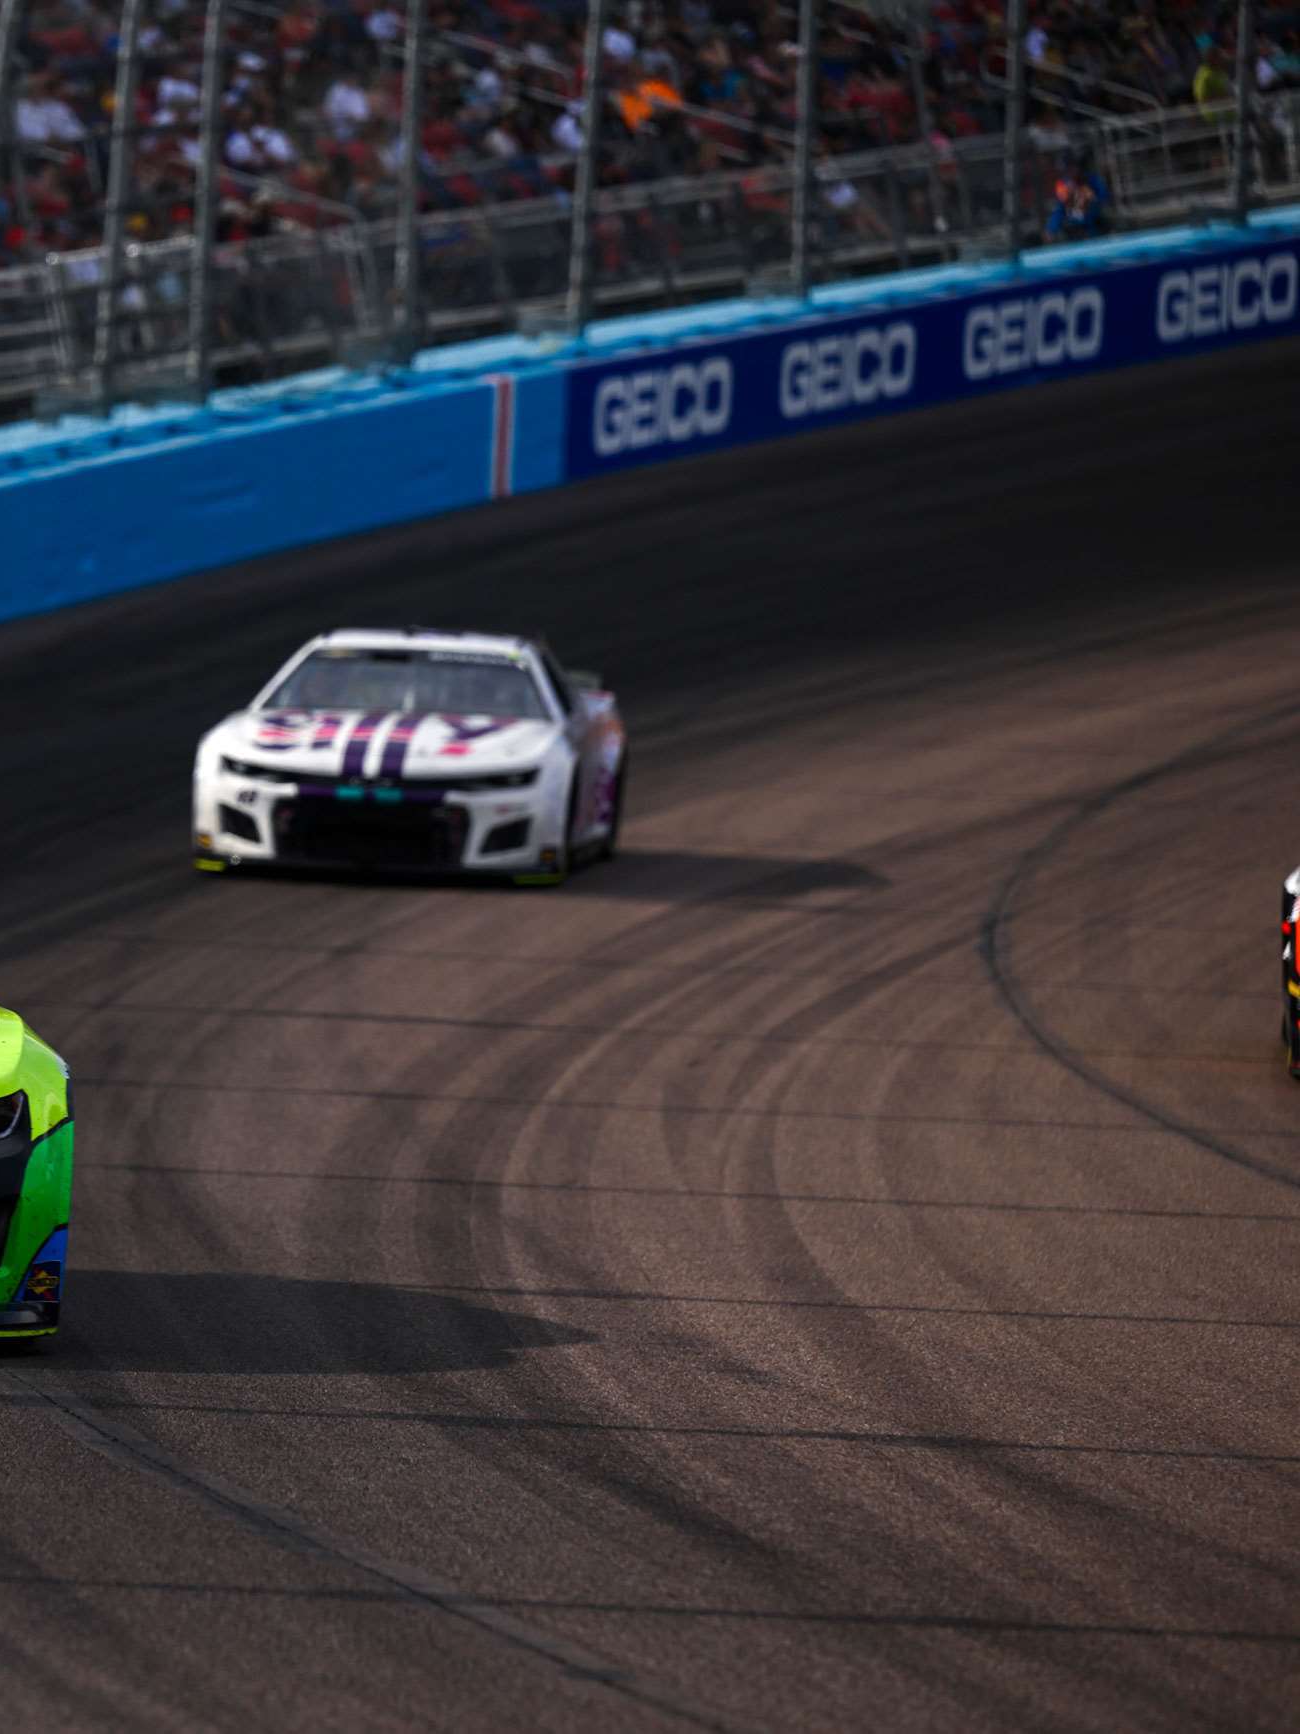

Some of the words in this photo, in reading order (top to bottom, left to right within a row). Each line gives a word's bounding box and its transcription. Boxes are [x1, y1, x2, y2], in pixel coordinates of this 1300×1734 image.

[963, 287, 1102, 380] GEICO
[1156, 254, 1299, 343] GEICO
[593, 356, 733, 456] GEICO
[779, 320, 916, 419] GEICO
